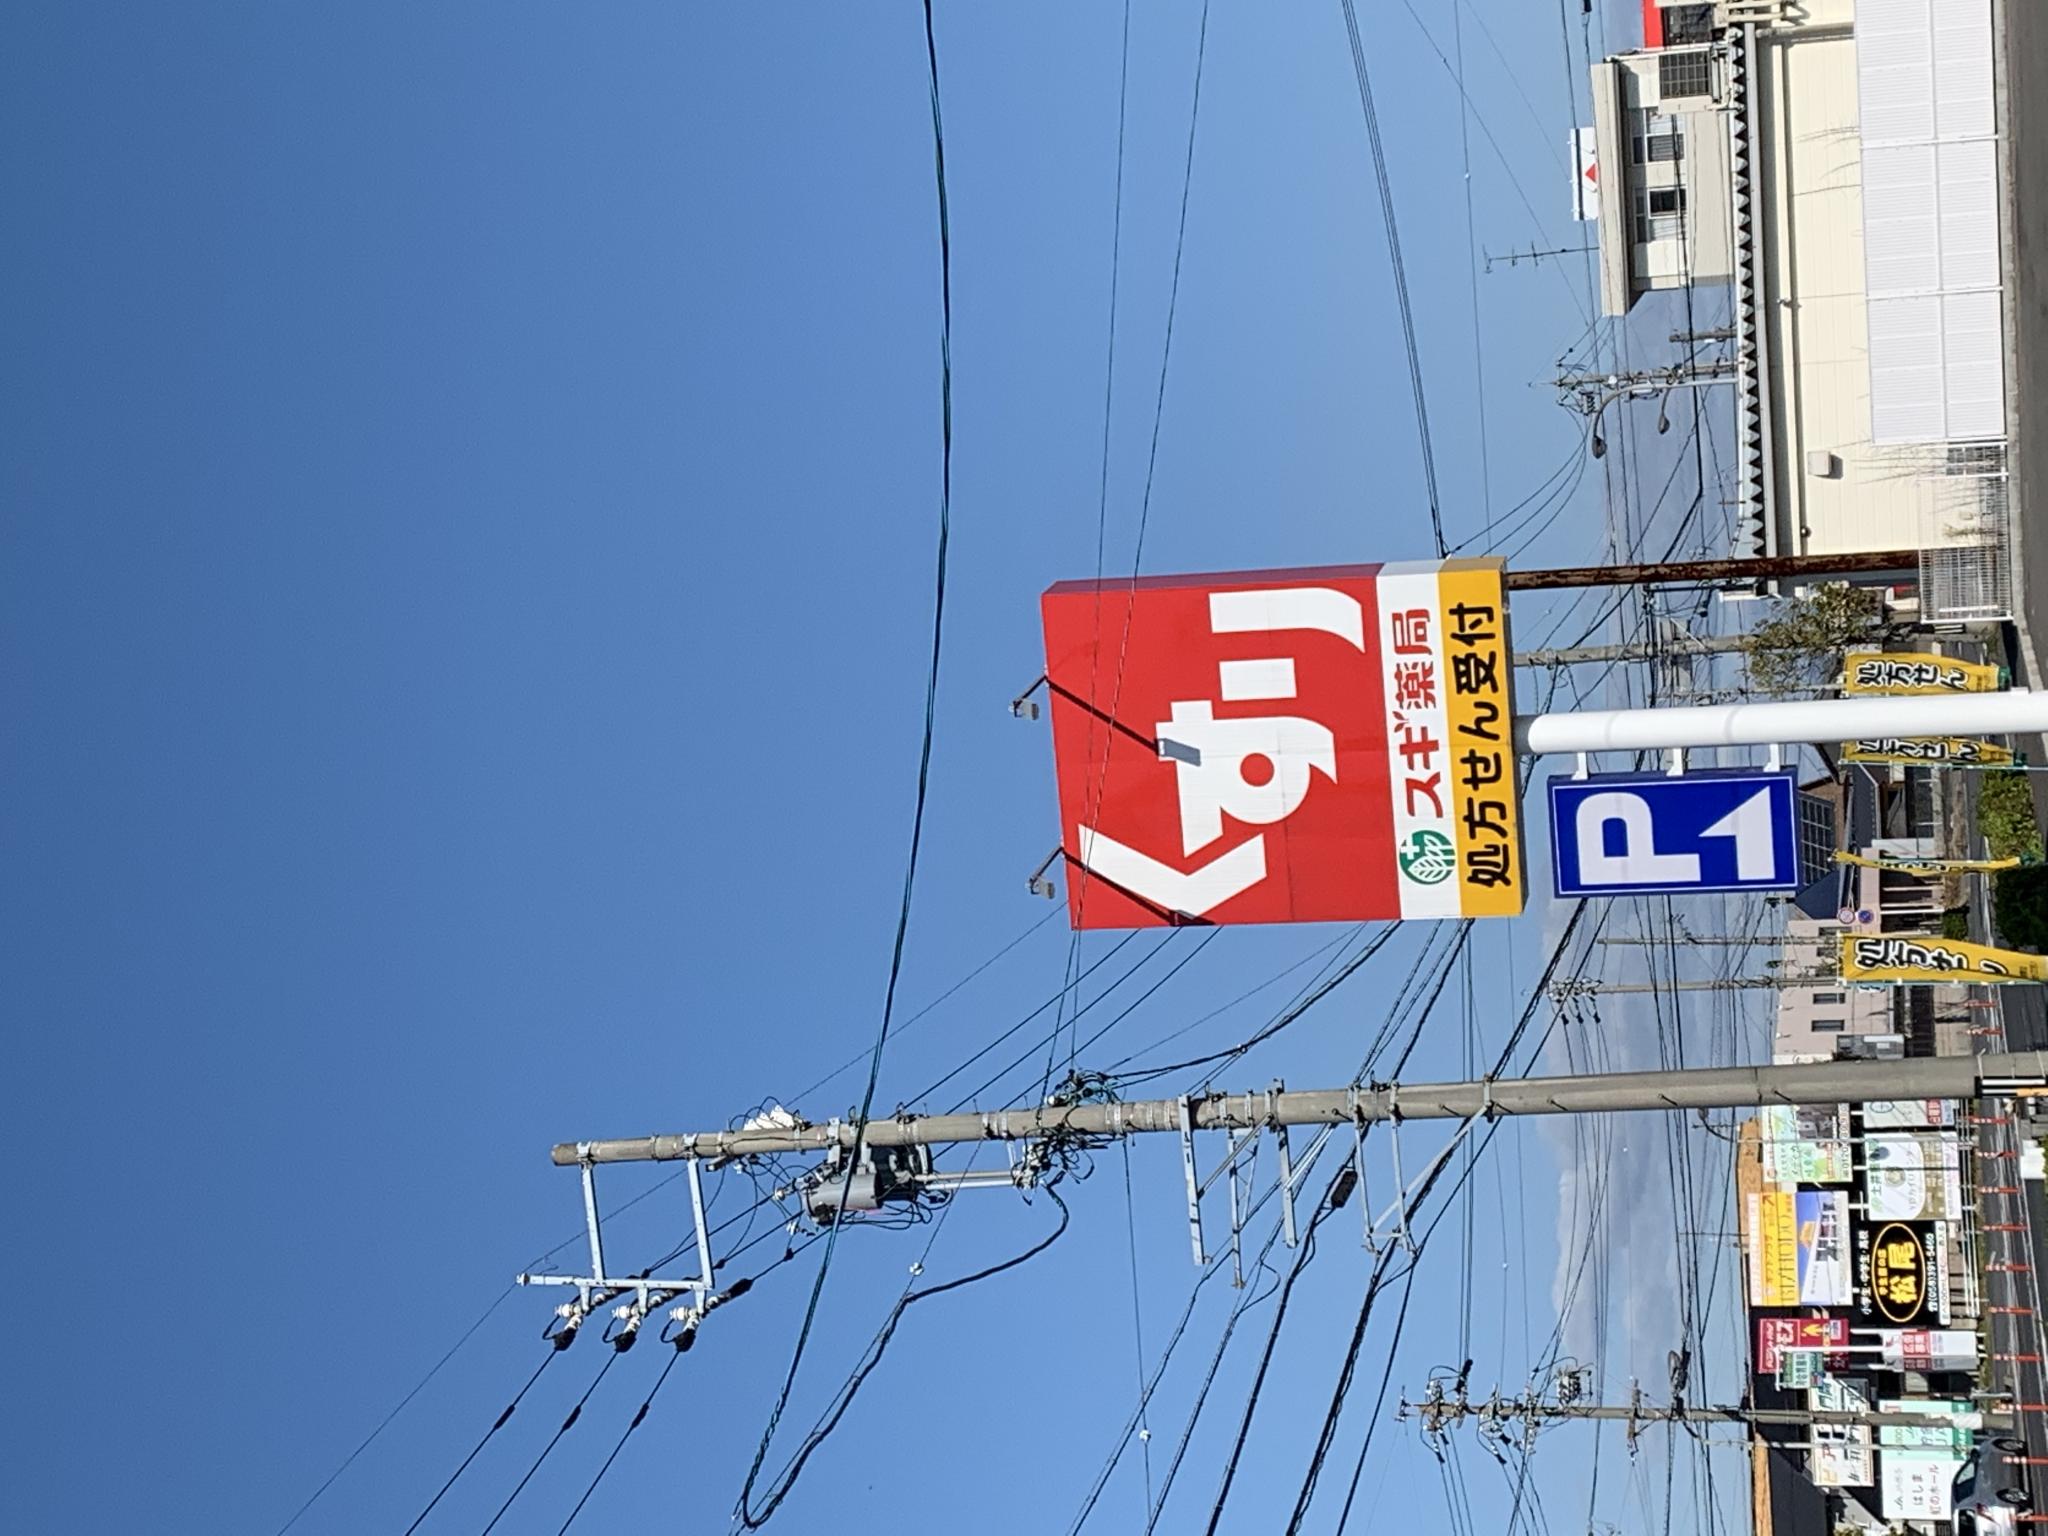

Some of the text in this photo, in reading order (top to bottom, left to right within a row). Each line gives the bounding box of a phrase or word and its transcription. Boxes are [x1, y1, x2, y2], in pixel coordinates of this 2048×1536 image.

[1078, 587, 1366, 918] くすり
[1391, 608, 1444, 818] スギ薬局
[1450, 602, 1512, 888] 処方せん受付
[1855, 661, 1970, 690] 処方せん
[1575, 792, 1702, 885] P
